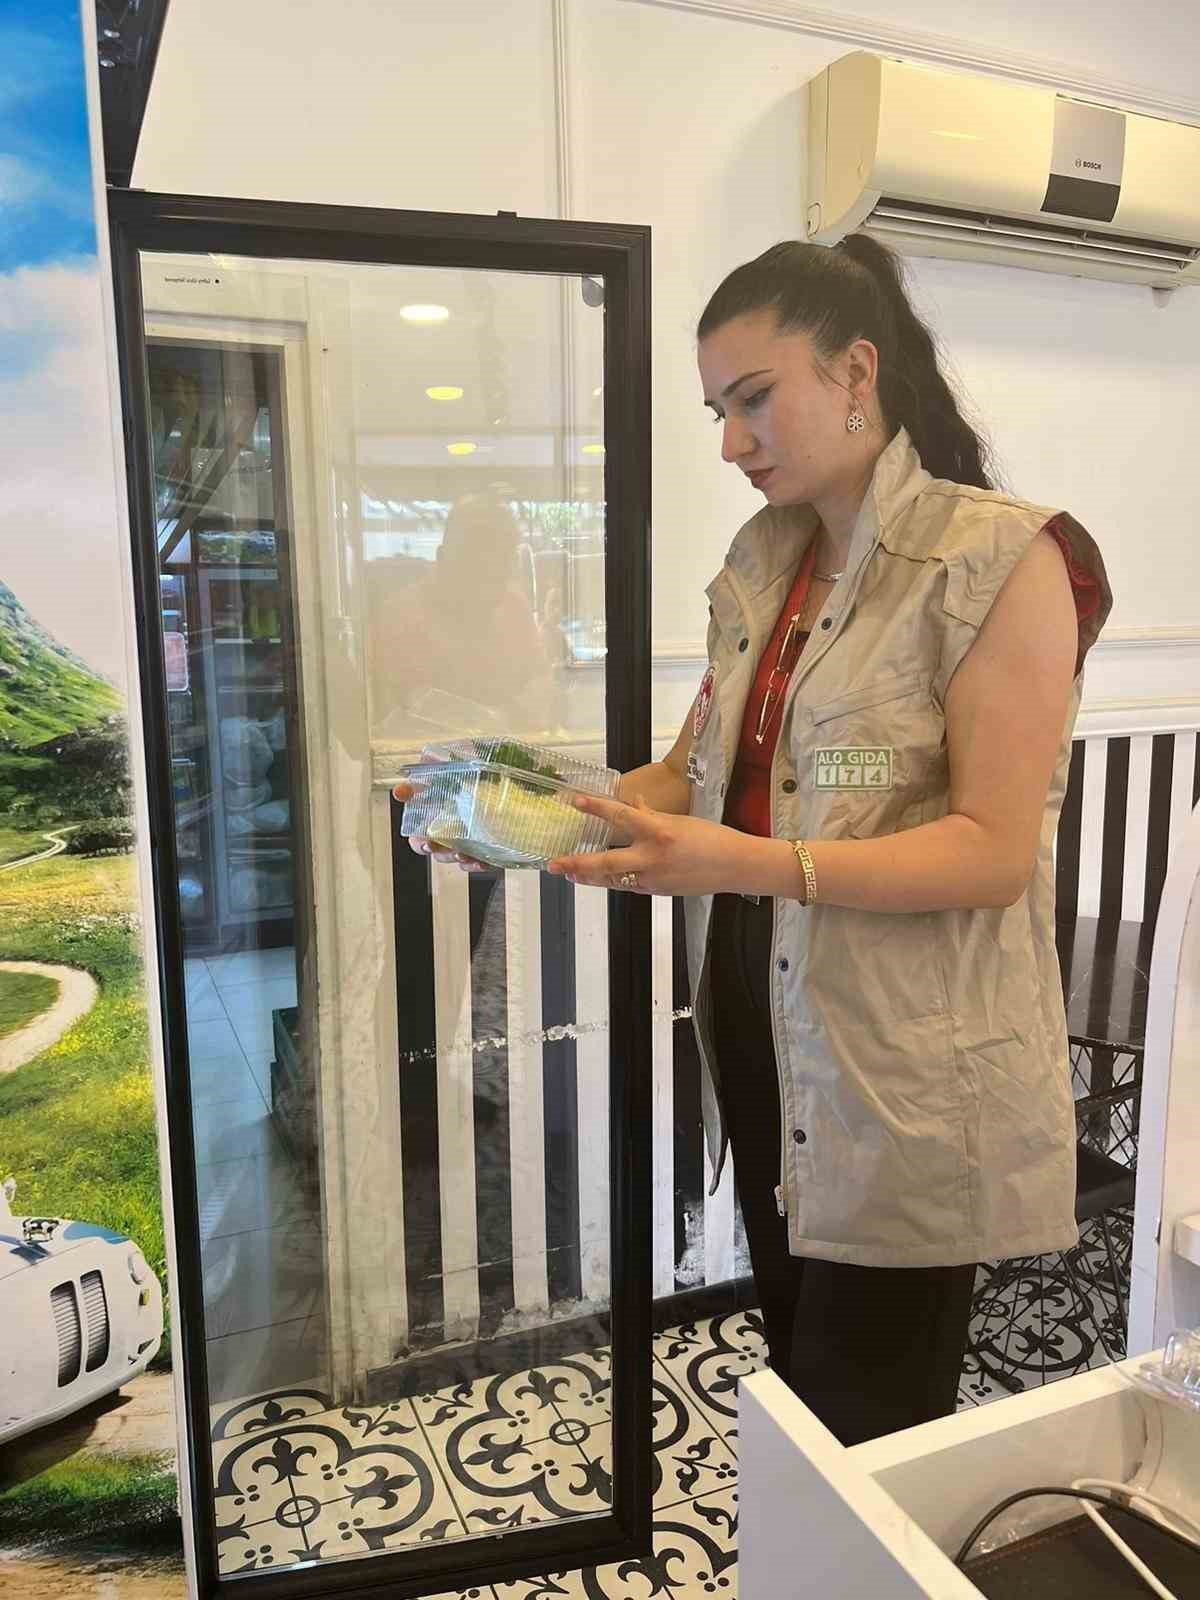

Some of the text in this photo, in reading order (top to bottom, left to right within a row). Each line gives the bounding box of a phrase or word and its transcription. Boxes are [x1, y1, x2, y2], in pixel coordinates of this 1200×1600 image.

[1083, 161, 1102, 170] BOSCH
[817, 751, 888, 765] ALO GIDA
